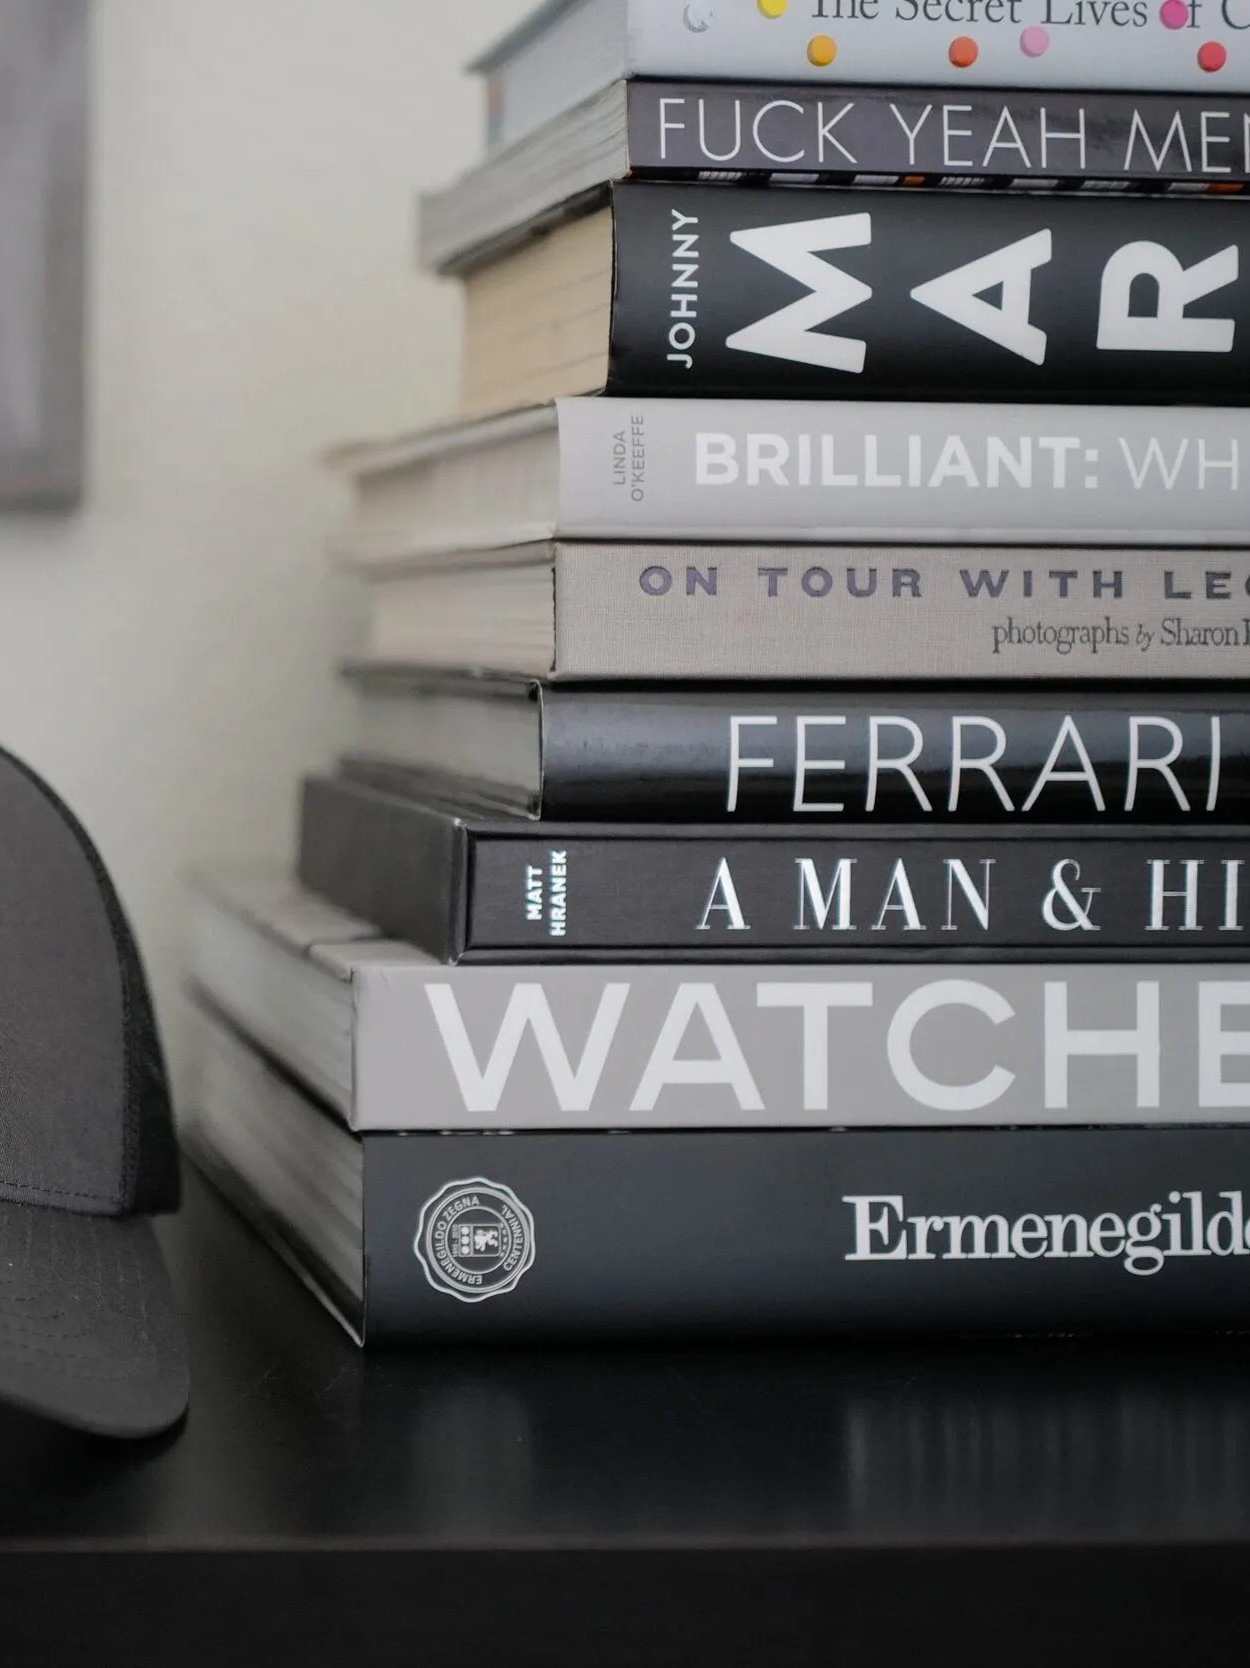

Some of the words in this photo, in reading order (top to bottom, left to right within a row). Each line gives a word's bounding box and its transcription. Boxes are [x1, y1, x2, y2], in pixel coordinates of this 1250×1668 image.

[659, 98, 858, 164] FUCK
[889, 103, 1086, 169] YEAH
[666, 208, 700, 370] JOHNNY
[612, 430, 626, 485] LINDA
[630, 414, 645, 502] O'KEEFFE
[695, 432, 1097, 489] BRILLIANT:
[639, 565, 718, 597] ON
[758, 566, 922, 598] TOUR
[959, 569, 1123, 599] WITH
[992, 615, 1130, 655] photographs
[1135, 623, 1155, 652] by
[1160, 617, 1240, 647] Sharon
[726, 714, 1221, 812] FERRARI
[525, 864, 543, 921] MATT
[549, 849, 567, 936] HRANEK
[695, 857, 751, 930] A
[793, 857, 997, 931] MAN
[1041, 858, 1102, 931] &
[1144, 859, 1245, 931] HI
[424, 979, 1250, 1112] WATCHE
[443, 1195, 481, 1222] ZEGNA
[501, 1204, 524, 1272] CENTENNIAL
[842, 1190, 1250, 1276] Ermenegild
[434, 1222, 483, 1285] ERMENEGILDO
